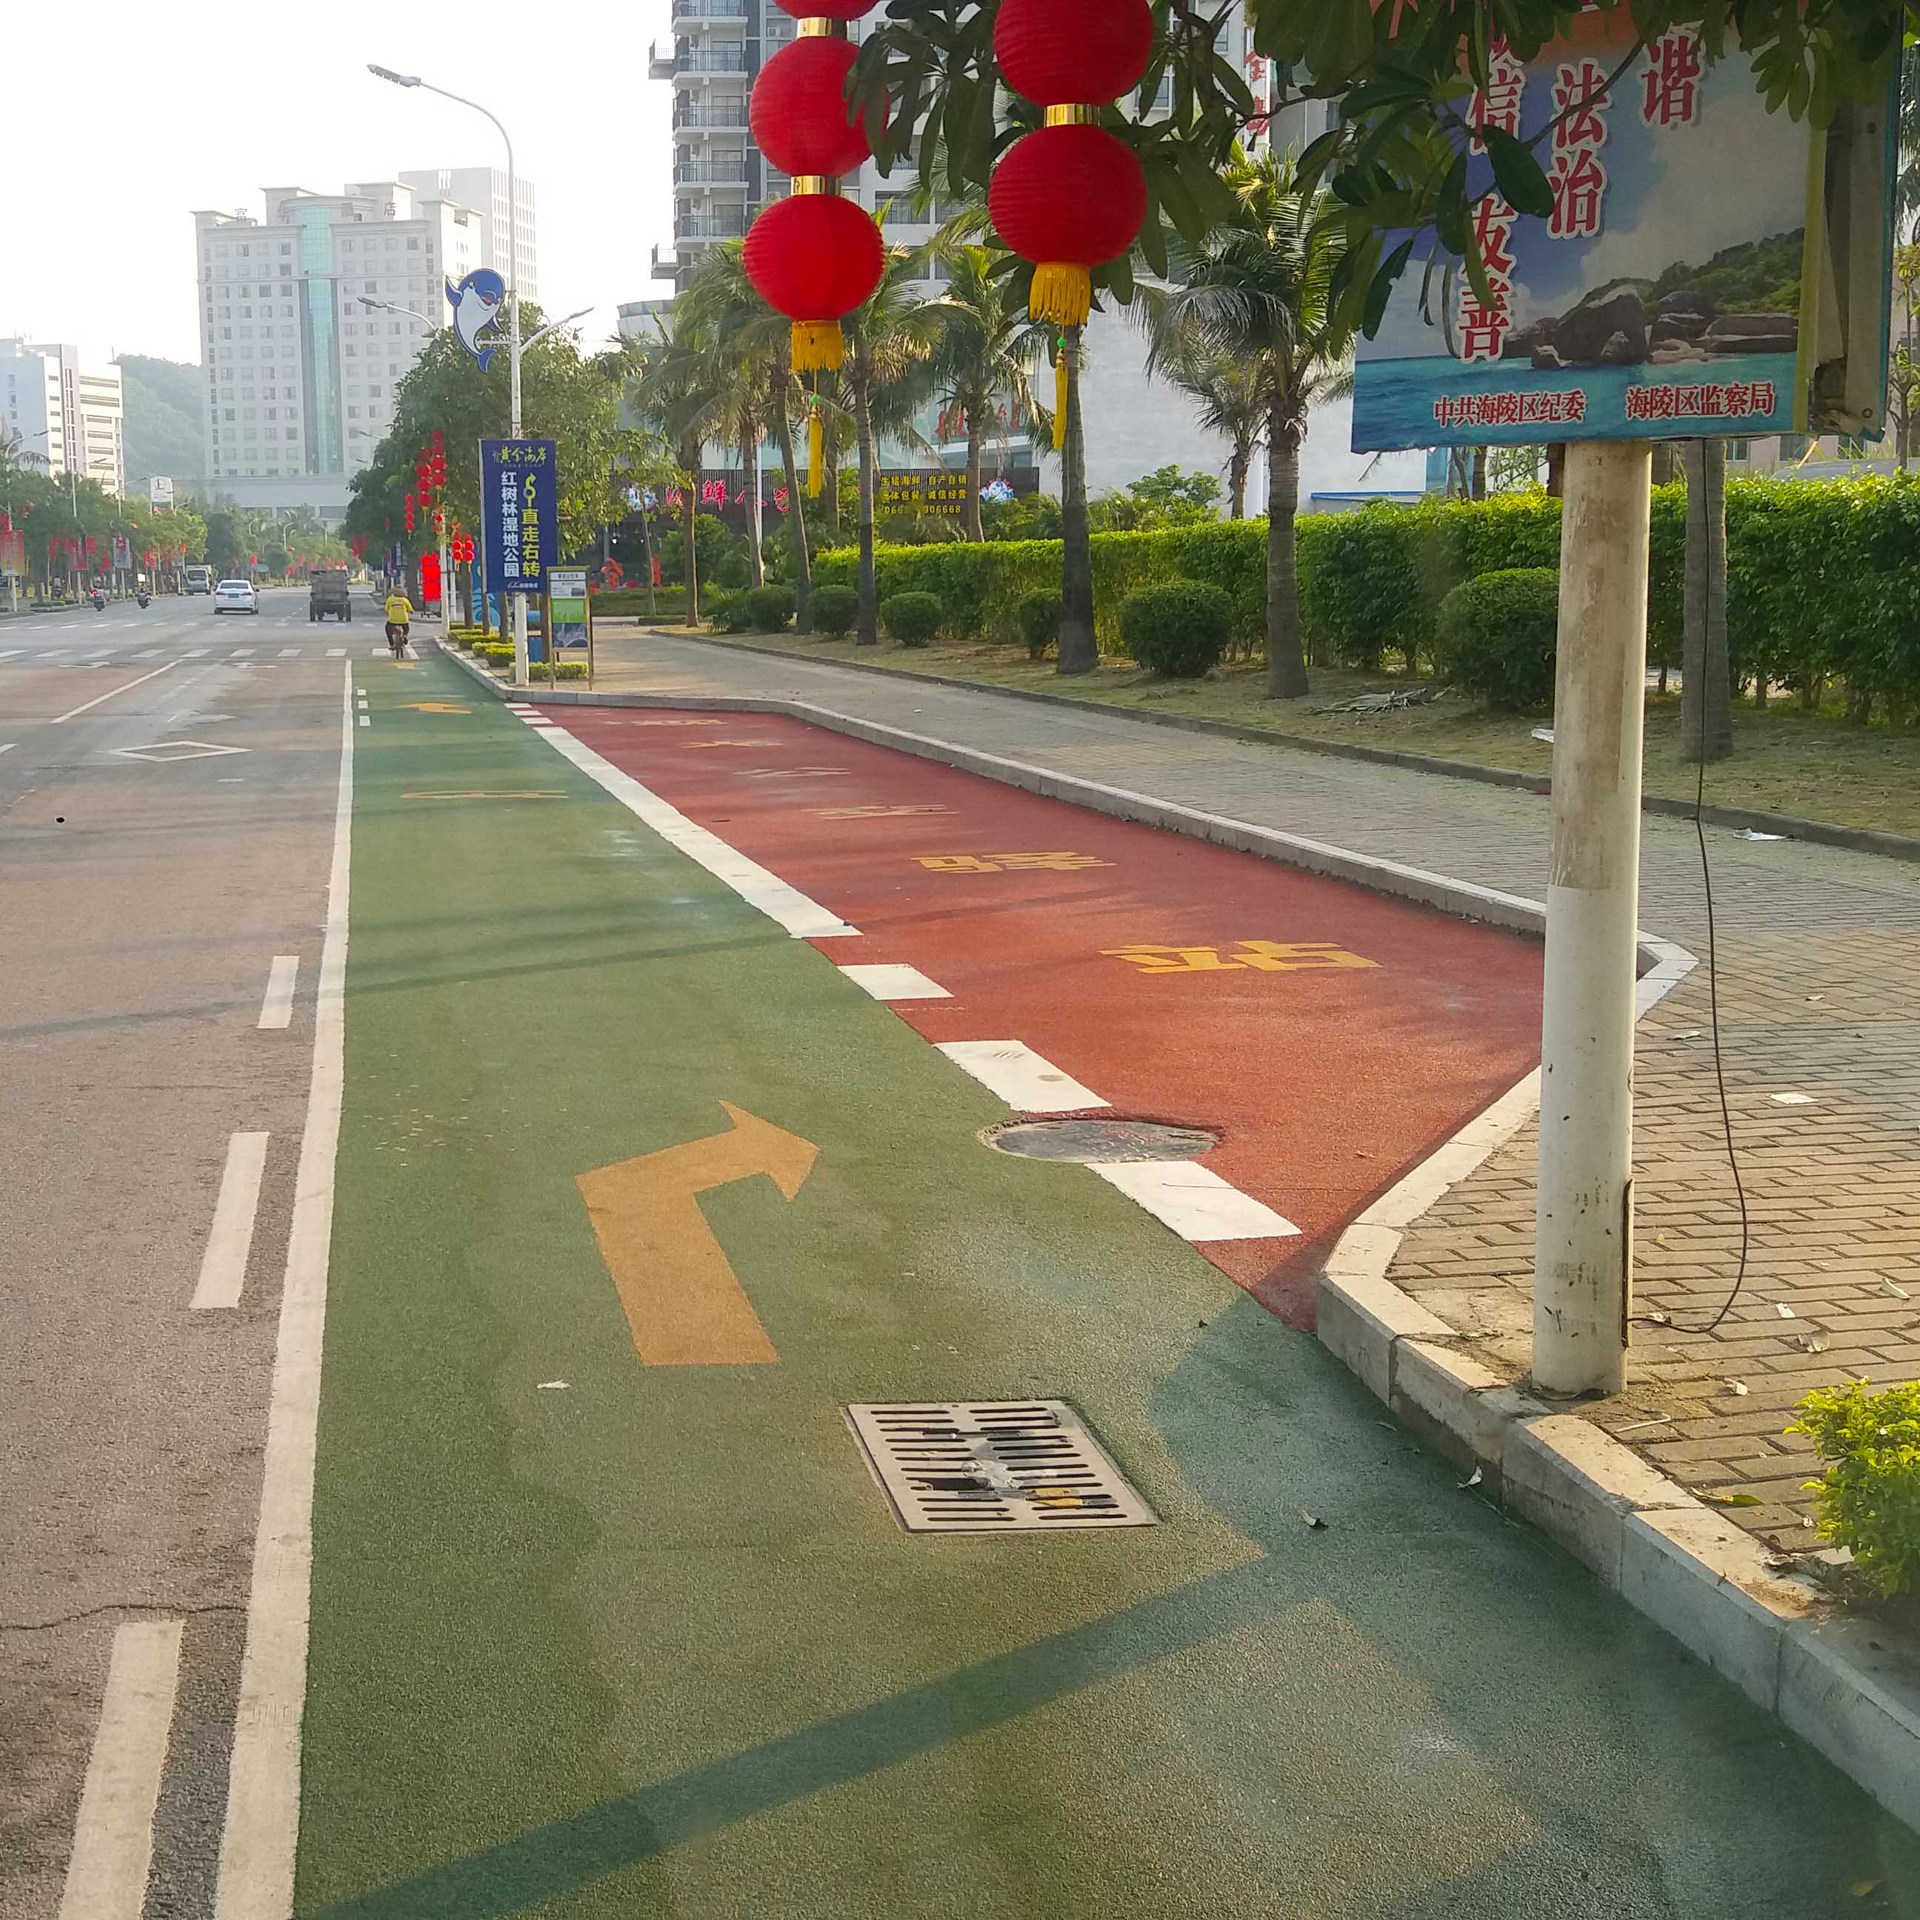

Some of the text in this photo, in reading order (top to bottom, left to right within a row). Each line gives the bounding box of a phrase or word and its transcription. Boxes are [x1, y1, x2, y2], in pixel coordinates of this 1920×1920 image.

[1641, 36, 1701, 125] 谐
[1549, 63, 1608, 233] 法治
[1434, 382, 1774, 427] 中共海陵区纪委 海陵区监察局
[501, 471, 520, 578] 红树林湿地公园
[521, 508, 541, 577] 直走右转
